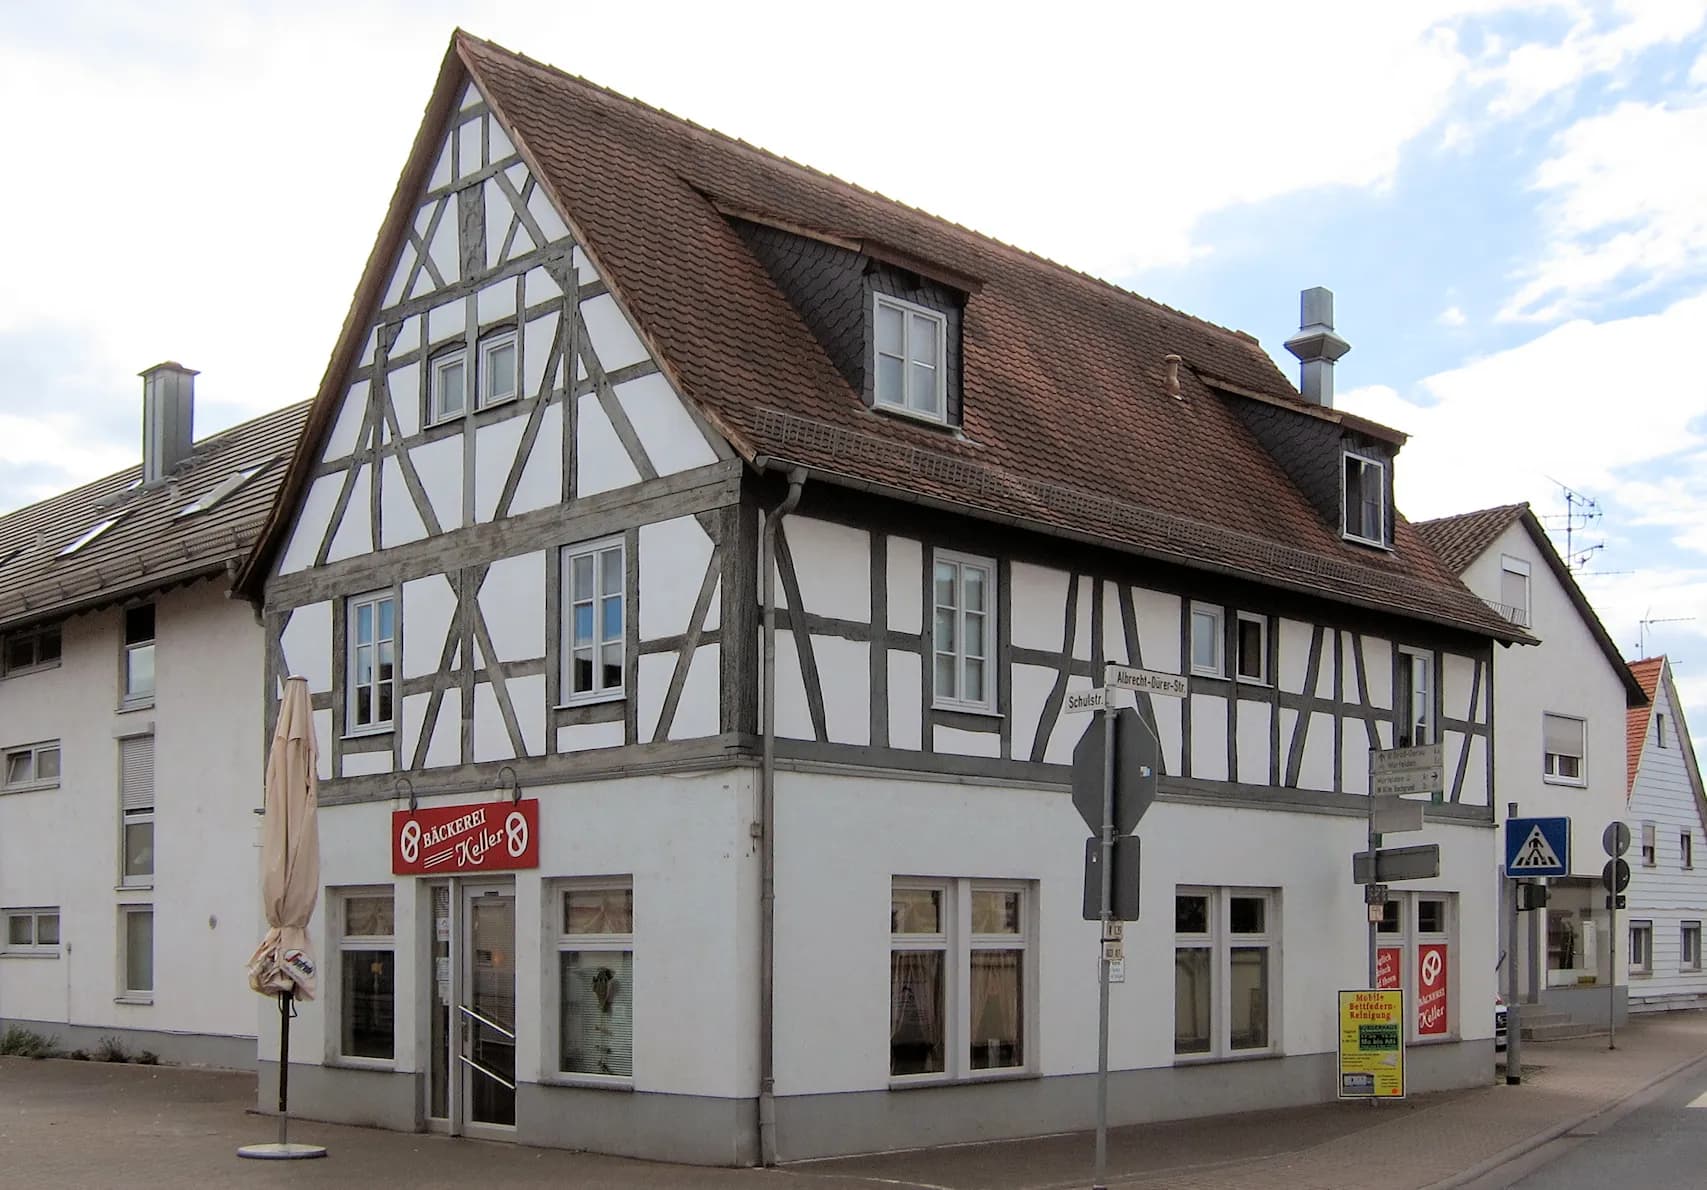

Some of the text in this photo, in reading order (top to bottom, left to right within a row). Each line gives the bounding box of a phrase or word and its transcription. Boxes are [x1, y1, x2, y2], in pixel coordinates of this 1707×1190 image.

[1117, 671, 1186, 694] Albrecht-Dürer-Str.
[1069, 694, 1104, 709] Schulstr.
[423, 808, 486, 848] BÄCKEREI
[455, 828, 504, 867] Keller
[1419, 1004, 1445, 1029] Keller
